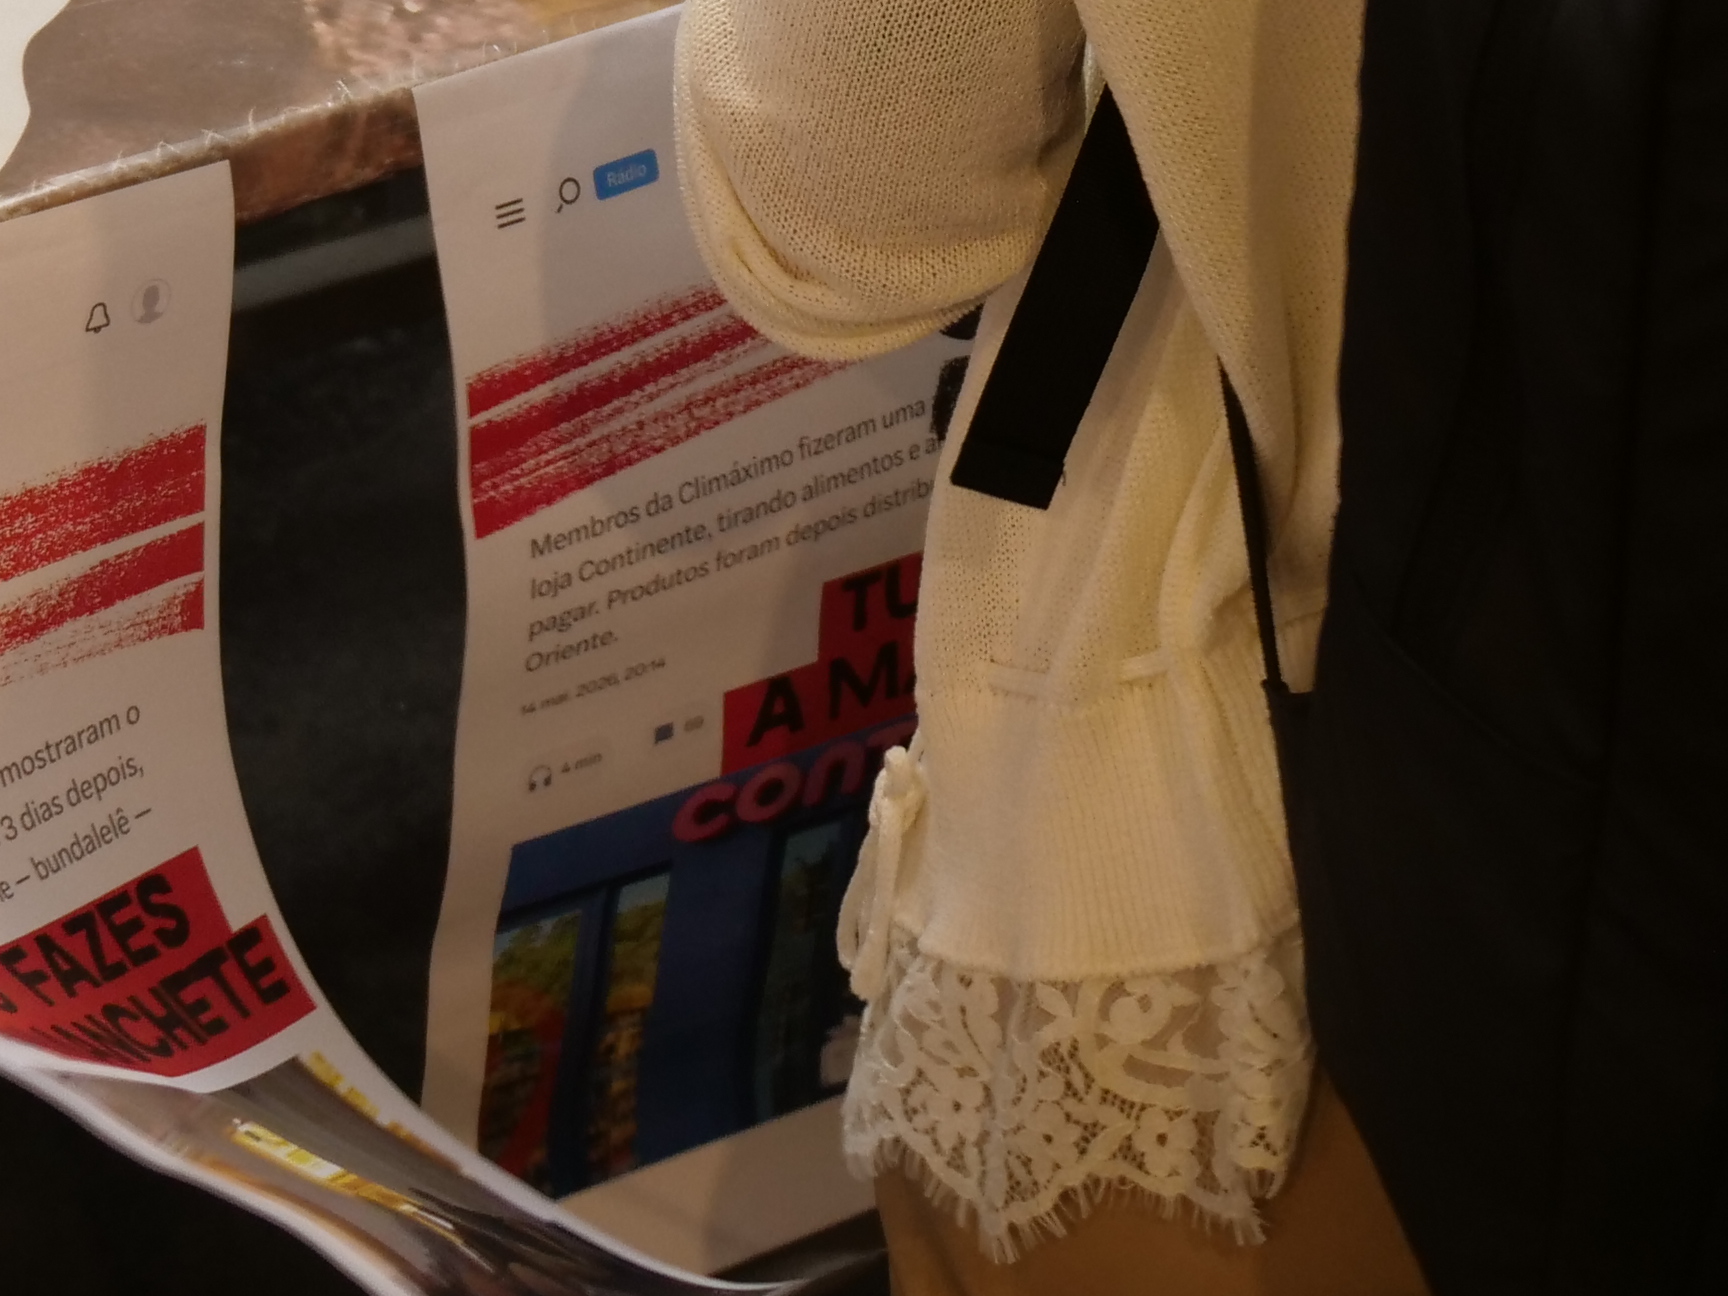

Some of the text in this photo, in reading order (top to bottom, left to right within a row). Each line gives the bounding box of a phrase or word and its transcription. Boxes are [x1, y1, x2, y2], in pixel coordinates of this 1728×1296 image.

[528, 401, 927, 559] Membros da Climáximo fizeram uma
[529, 569, 573, 600] loja
[577, 519, 714, 583] Continente,
[715, 489, 799, 535] tirando
[801, 446, 906, 505] alimentos
[908, 442, 921, 462] e
[527, 596, 600, 643] pagar.
[606, 560, 711, 613] Produtos
[713, 534, 782, 573] foram
[783, 506, 859, 547] depois
[841, 559, 920, 633] TU
[523, 627, 620, 674] Oriente.
[744, 640, 918, 749] A M
[125, 704, 142, 726] o
[0, 814, 20, 841] 3
[18, 787, 66, 831] dias
[65, 753, 146, 807] depois,
[31, 807, 132, 883] bundalelê
